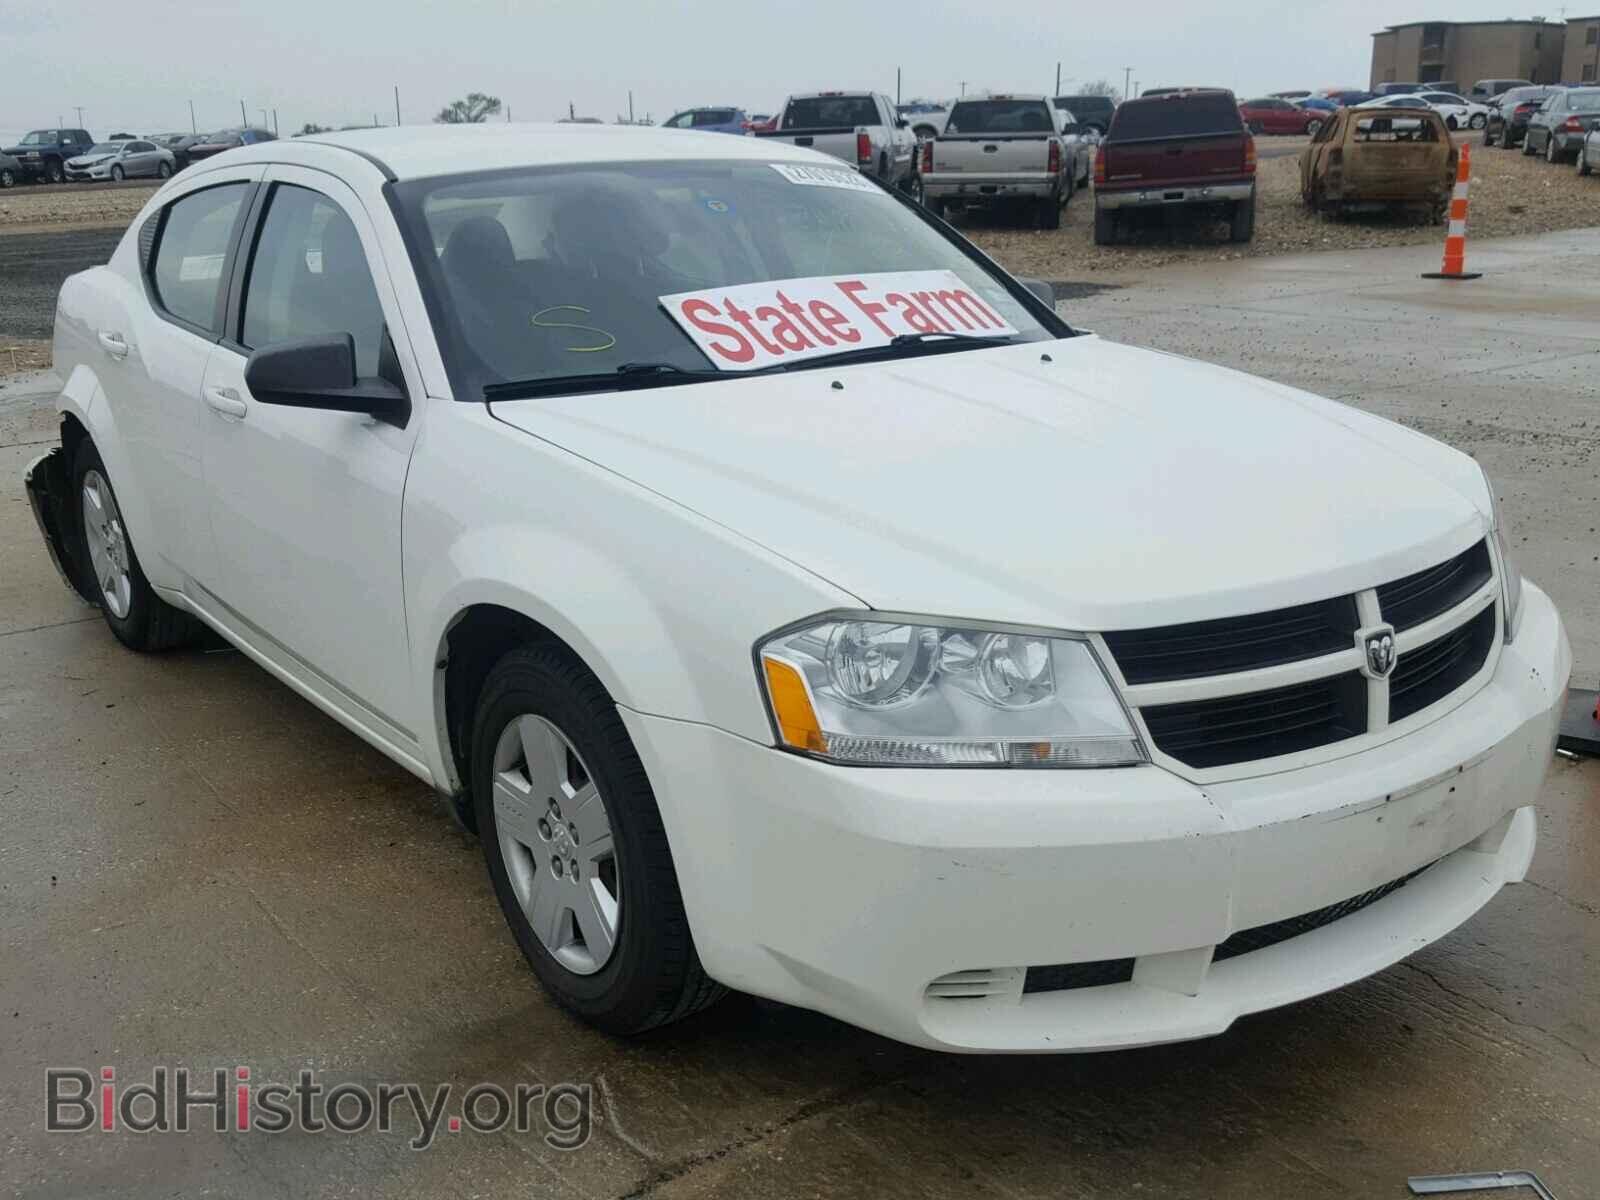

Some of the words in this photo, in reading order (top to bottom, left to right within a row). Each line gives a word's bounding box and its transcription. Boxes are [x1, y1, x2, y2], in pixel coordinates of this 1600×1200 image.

[531, 305, 616, 351] S
[681, 289, 862, 363] State
[834, 280, 1005, 338] Farm
